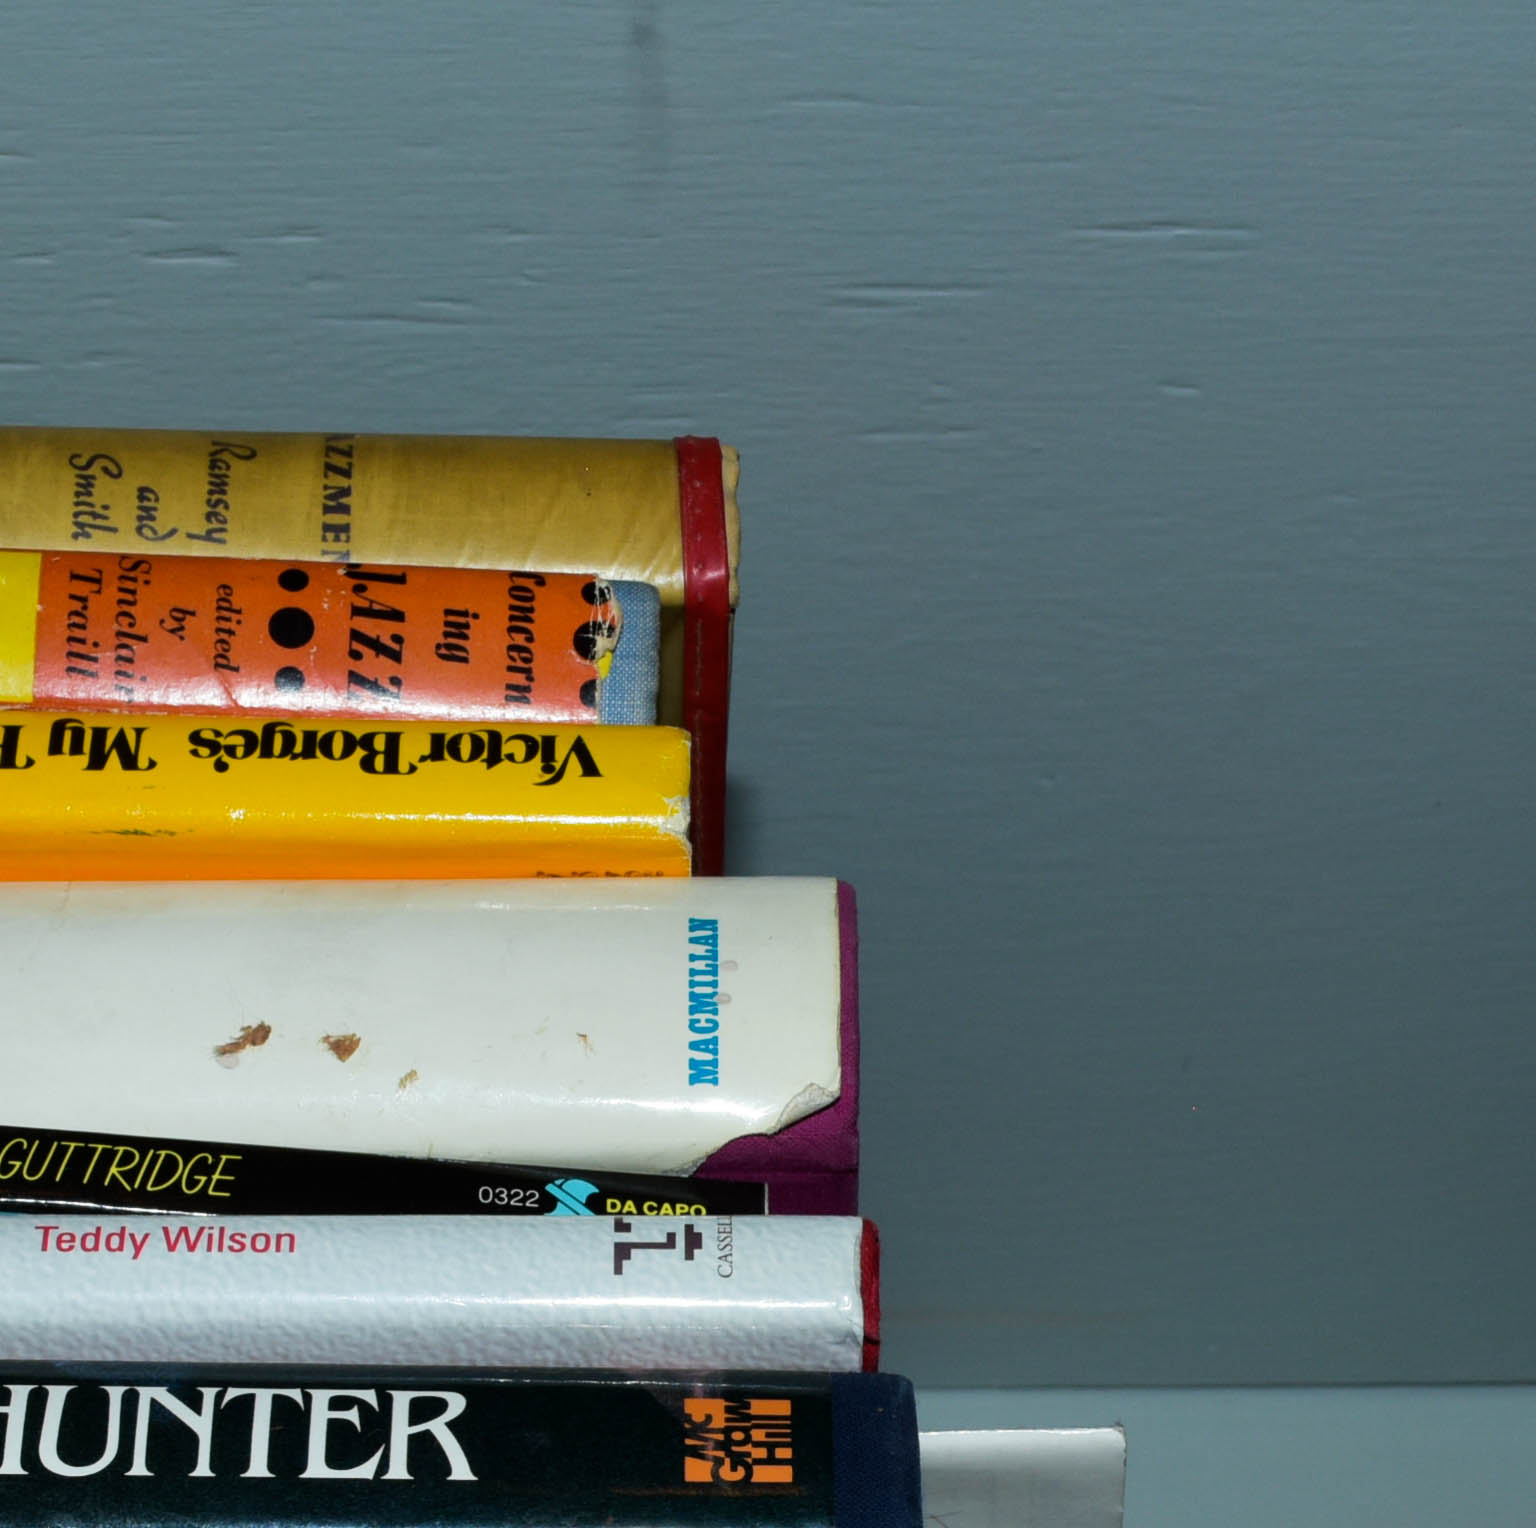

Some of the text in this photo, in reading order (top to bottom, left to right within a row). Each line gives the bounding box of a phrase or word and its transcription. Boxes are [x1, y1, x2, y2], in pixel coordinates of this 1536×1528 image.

[68, 453, 123, 541] Smith
[136, 486, 179, 542] and
[186, 439, 257, 544] Ramsey
[64, 567, 102, 679] Traill
[114, 556, 152, 702] Sinclair
[160, 605, 196, 643] by
[214, 583, 242, 673] edited
[345, 563, 407, 700] JAZZ
[435, 608, 480, 664] ing
[505, 571, 546, 704] Concern
[49, 721, 158, 773] My
[188, 726, 418, 775] Borge's
[418, 729, 603, 786] Victor
[687, 917, 720, 1087] MACMILLAN
[478, 1185, 540, 1208] 0322
[606, 1198, 707, 1215] DA CAPO
[34, 1225, 296, 1260] Teddy Wilson
[717, 1215, 733, 1278] CASSEL
